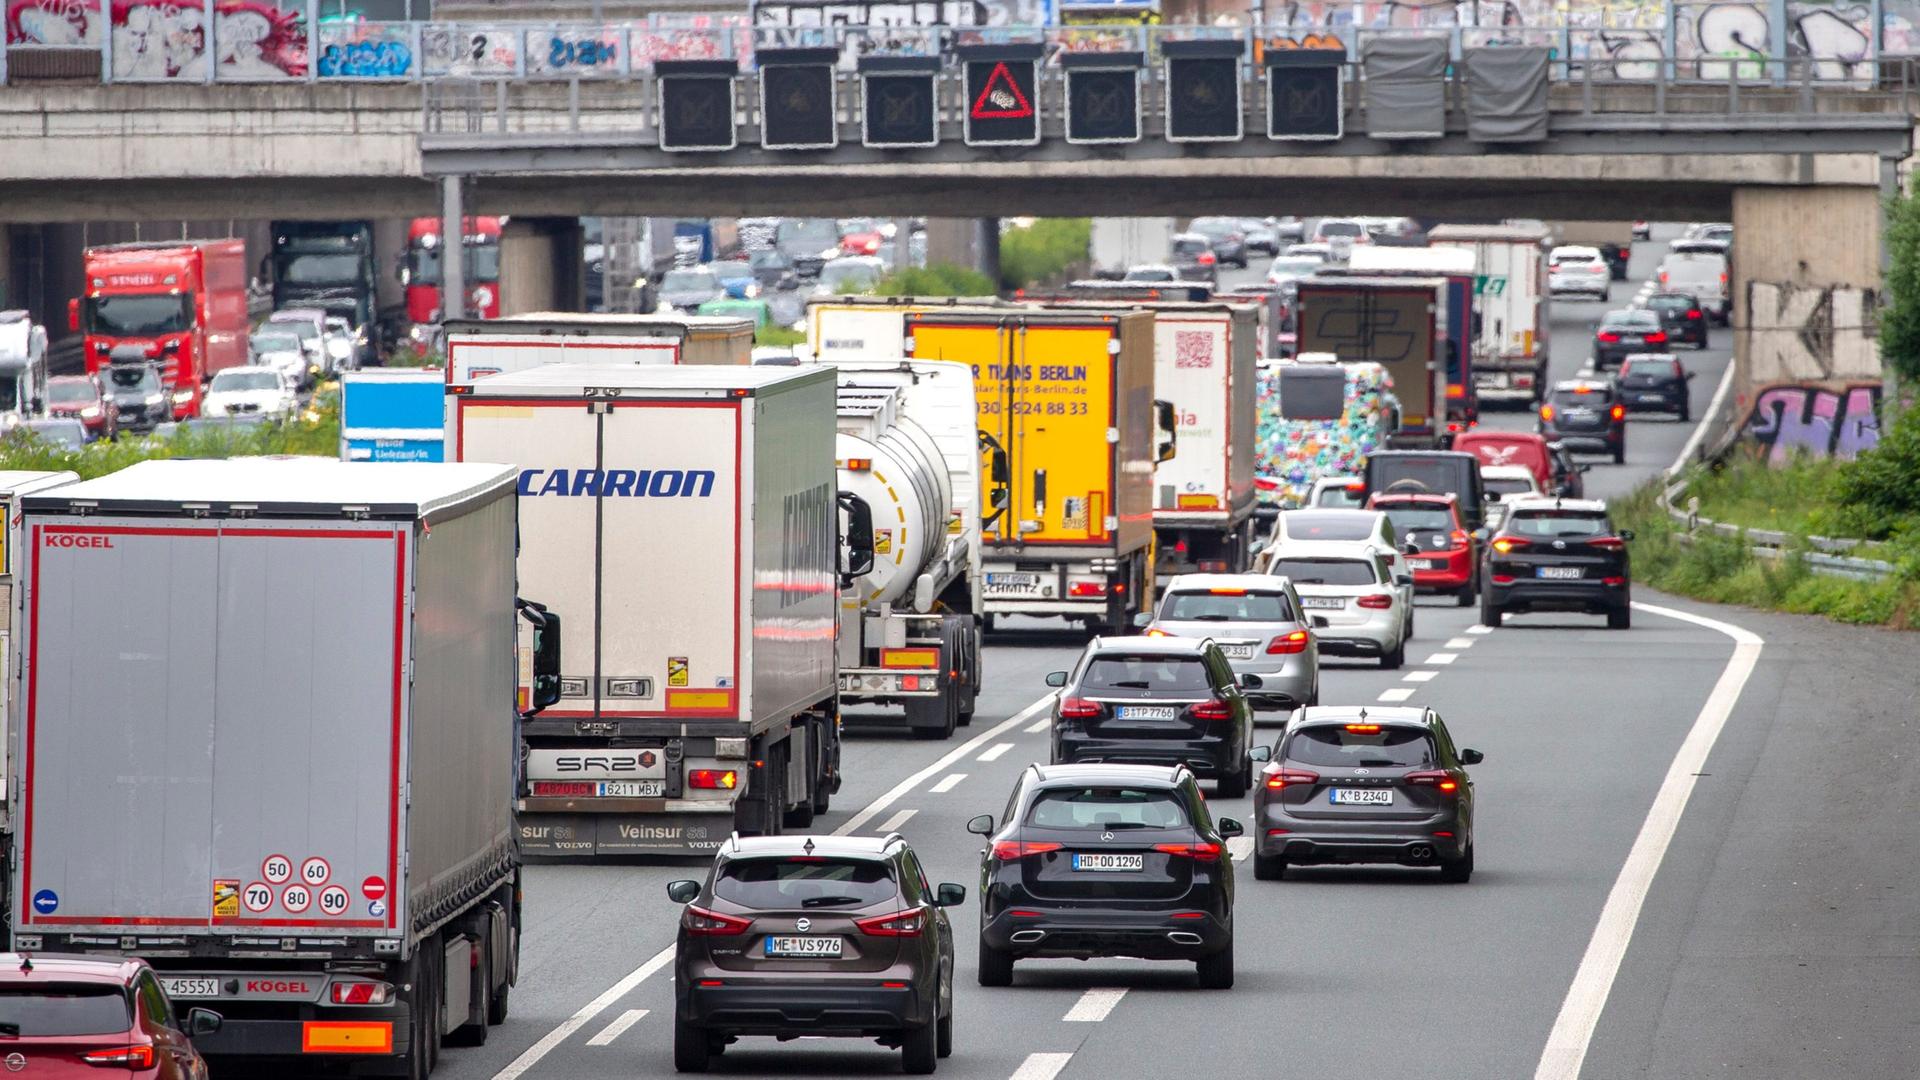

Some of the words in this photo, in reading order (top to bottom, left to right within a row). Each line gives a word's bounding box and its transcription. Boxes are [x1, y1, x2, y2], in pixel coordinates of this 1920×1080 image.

[988, 364, 1032, 380] TRANS
[1040, 365, 1086, 381] BERLIN
[1013, 402, 1041, 415] 924
[1047, 402, 1065, 415] 88
[1070, 402, 1088, 415] 33
[518, 469, 715, 497] CARRION
[46, 535, 113, 548] KÖGEL
[1233, 647, 1248, 656] 331
[1136, 708, 1148, 718] TP
[1150, 708, 1173, 718] 7766
[607, 783, 634, 796] 6211
[638, 784, 660, 796] MBX
[1340, 790, 1347, 800] K
[1354, 791, 1361, 801] B
[1362, 791, 1388, 802] 2340
[619, 825, 683, 839] Veinsur
[1080, 856, 1093, 867] HD
[1116, 857, 1142, 868] 1296
[268, 863, 287, 876] 50
[307, 865, 325, 879] 60
[248, 890, 269, 905] 70
[287, 891, 306, 905] 80
[324, 893, 345, 908] 90
[774, 939, 790, 951] ME
[799, 939, 815, 951] VS
[816, 940, 840, 952] 976
[171, 979, 215, 995] 4555X
[247, 980, 309, 993] KÖGEL
